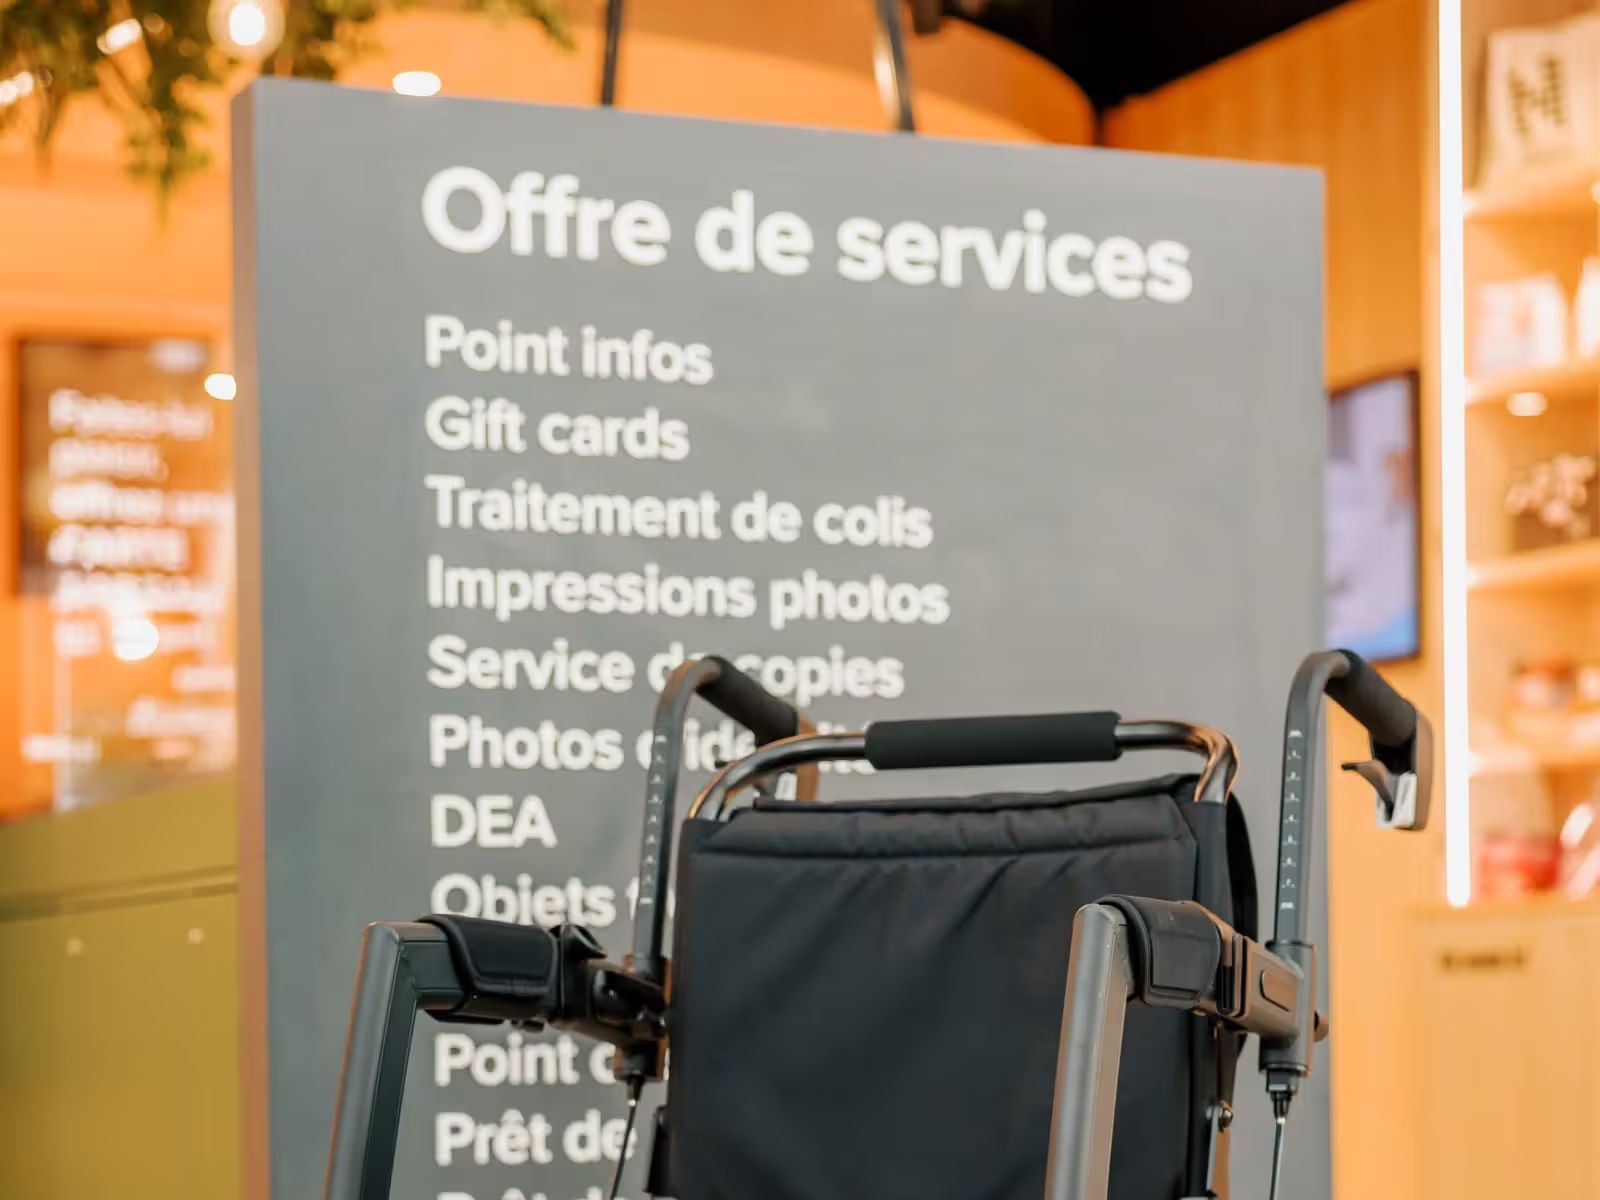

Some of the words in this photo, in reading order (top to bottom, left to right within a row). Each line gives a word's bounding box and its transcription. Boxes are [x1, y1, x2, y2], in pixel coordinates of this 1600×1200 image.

[421, 166, 672, 266] Offre
[694, 189, 815, 276] de
[836, 208, 1194, 303] services
[424, 314, 570, 376] Point
[581, 324, 714, 385] infos
[424, 395, 527, 454] Gift
[537, 406, 691, 461] cards
[423, 474, 722, 541] Traitement
[731, 490, 803, 543] de
[812, 495, 934, 549] colis
[427, 554, 757, 622] Impressions
[768, 569, 952, 630] photos
[426, 634, 637, 694] Service
[430, 714, 625, 771] Photos
[431, 794, 558, 848] DEA
[430, 872, 618, 928] Objets
[434, 1031, 580, 1087] Point
[434, 1108, 554, 1167] Prêt
[562, 1108, 639, 1163] de
